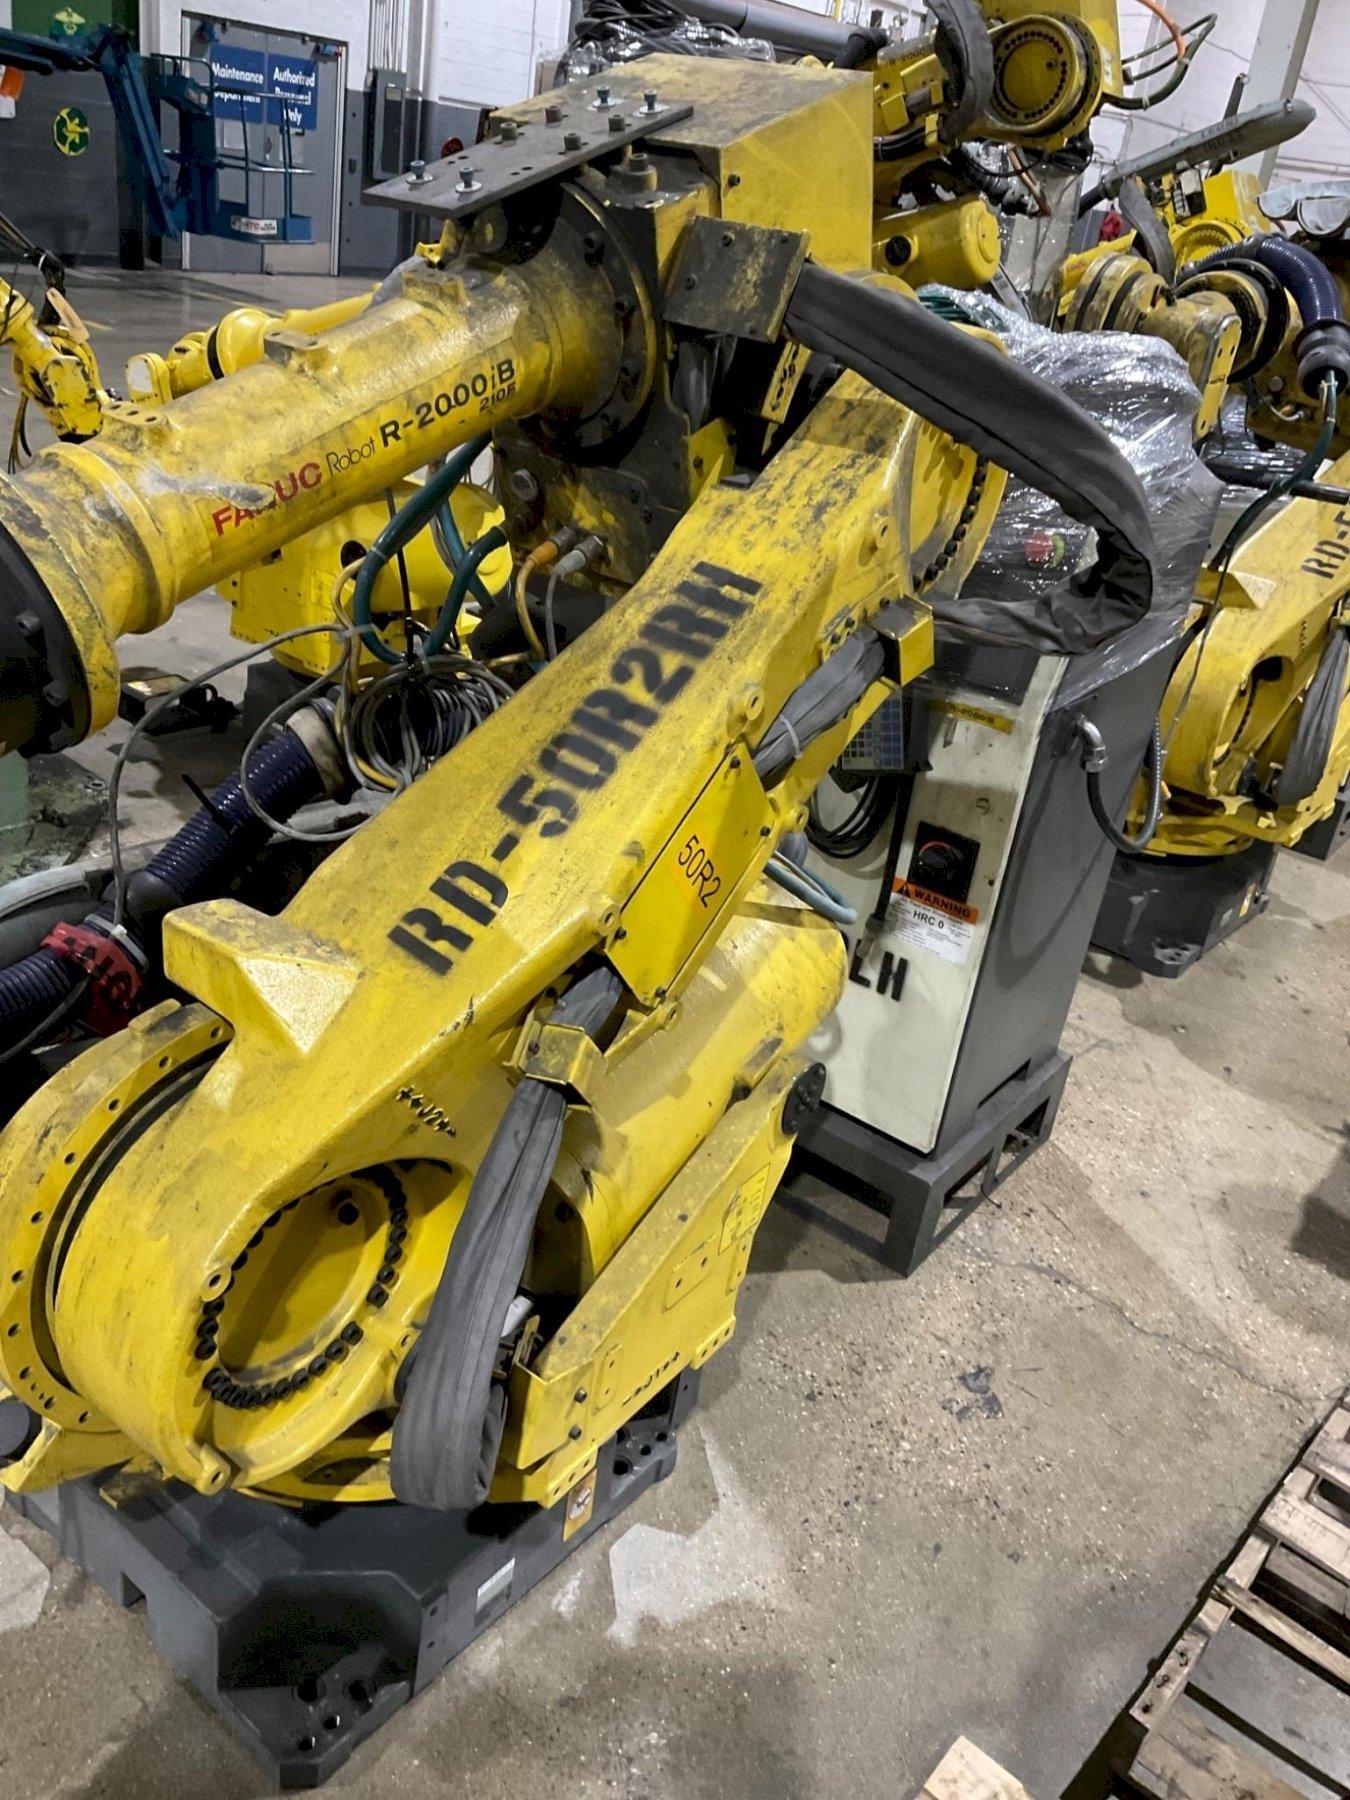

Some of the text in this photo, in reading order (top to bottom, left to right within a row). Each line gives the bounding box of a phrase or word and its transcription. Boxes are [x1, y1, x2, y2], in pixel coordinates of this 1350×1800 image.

[212, 62, 264, 84] Maintenance
[211, 358, 515, 537] FAUC Robot R-2000iB
[386, 560, 763, 977] RD-50R2RH
[678, 834, 721, 908] 50R2
[913, 910, 936, 926] HRC
[914, 888, 971, 918] WARNING
